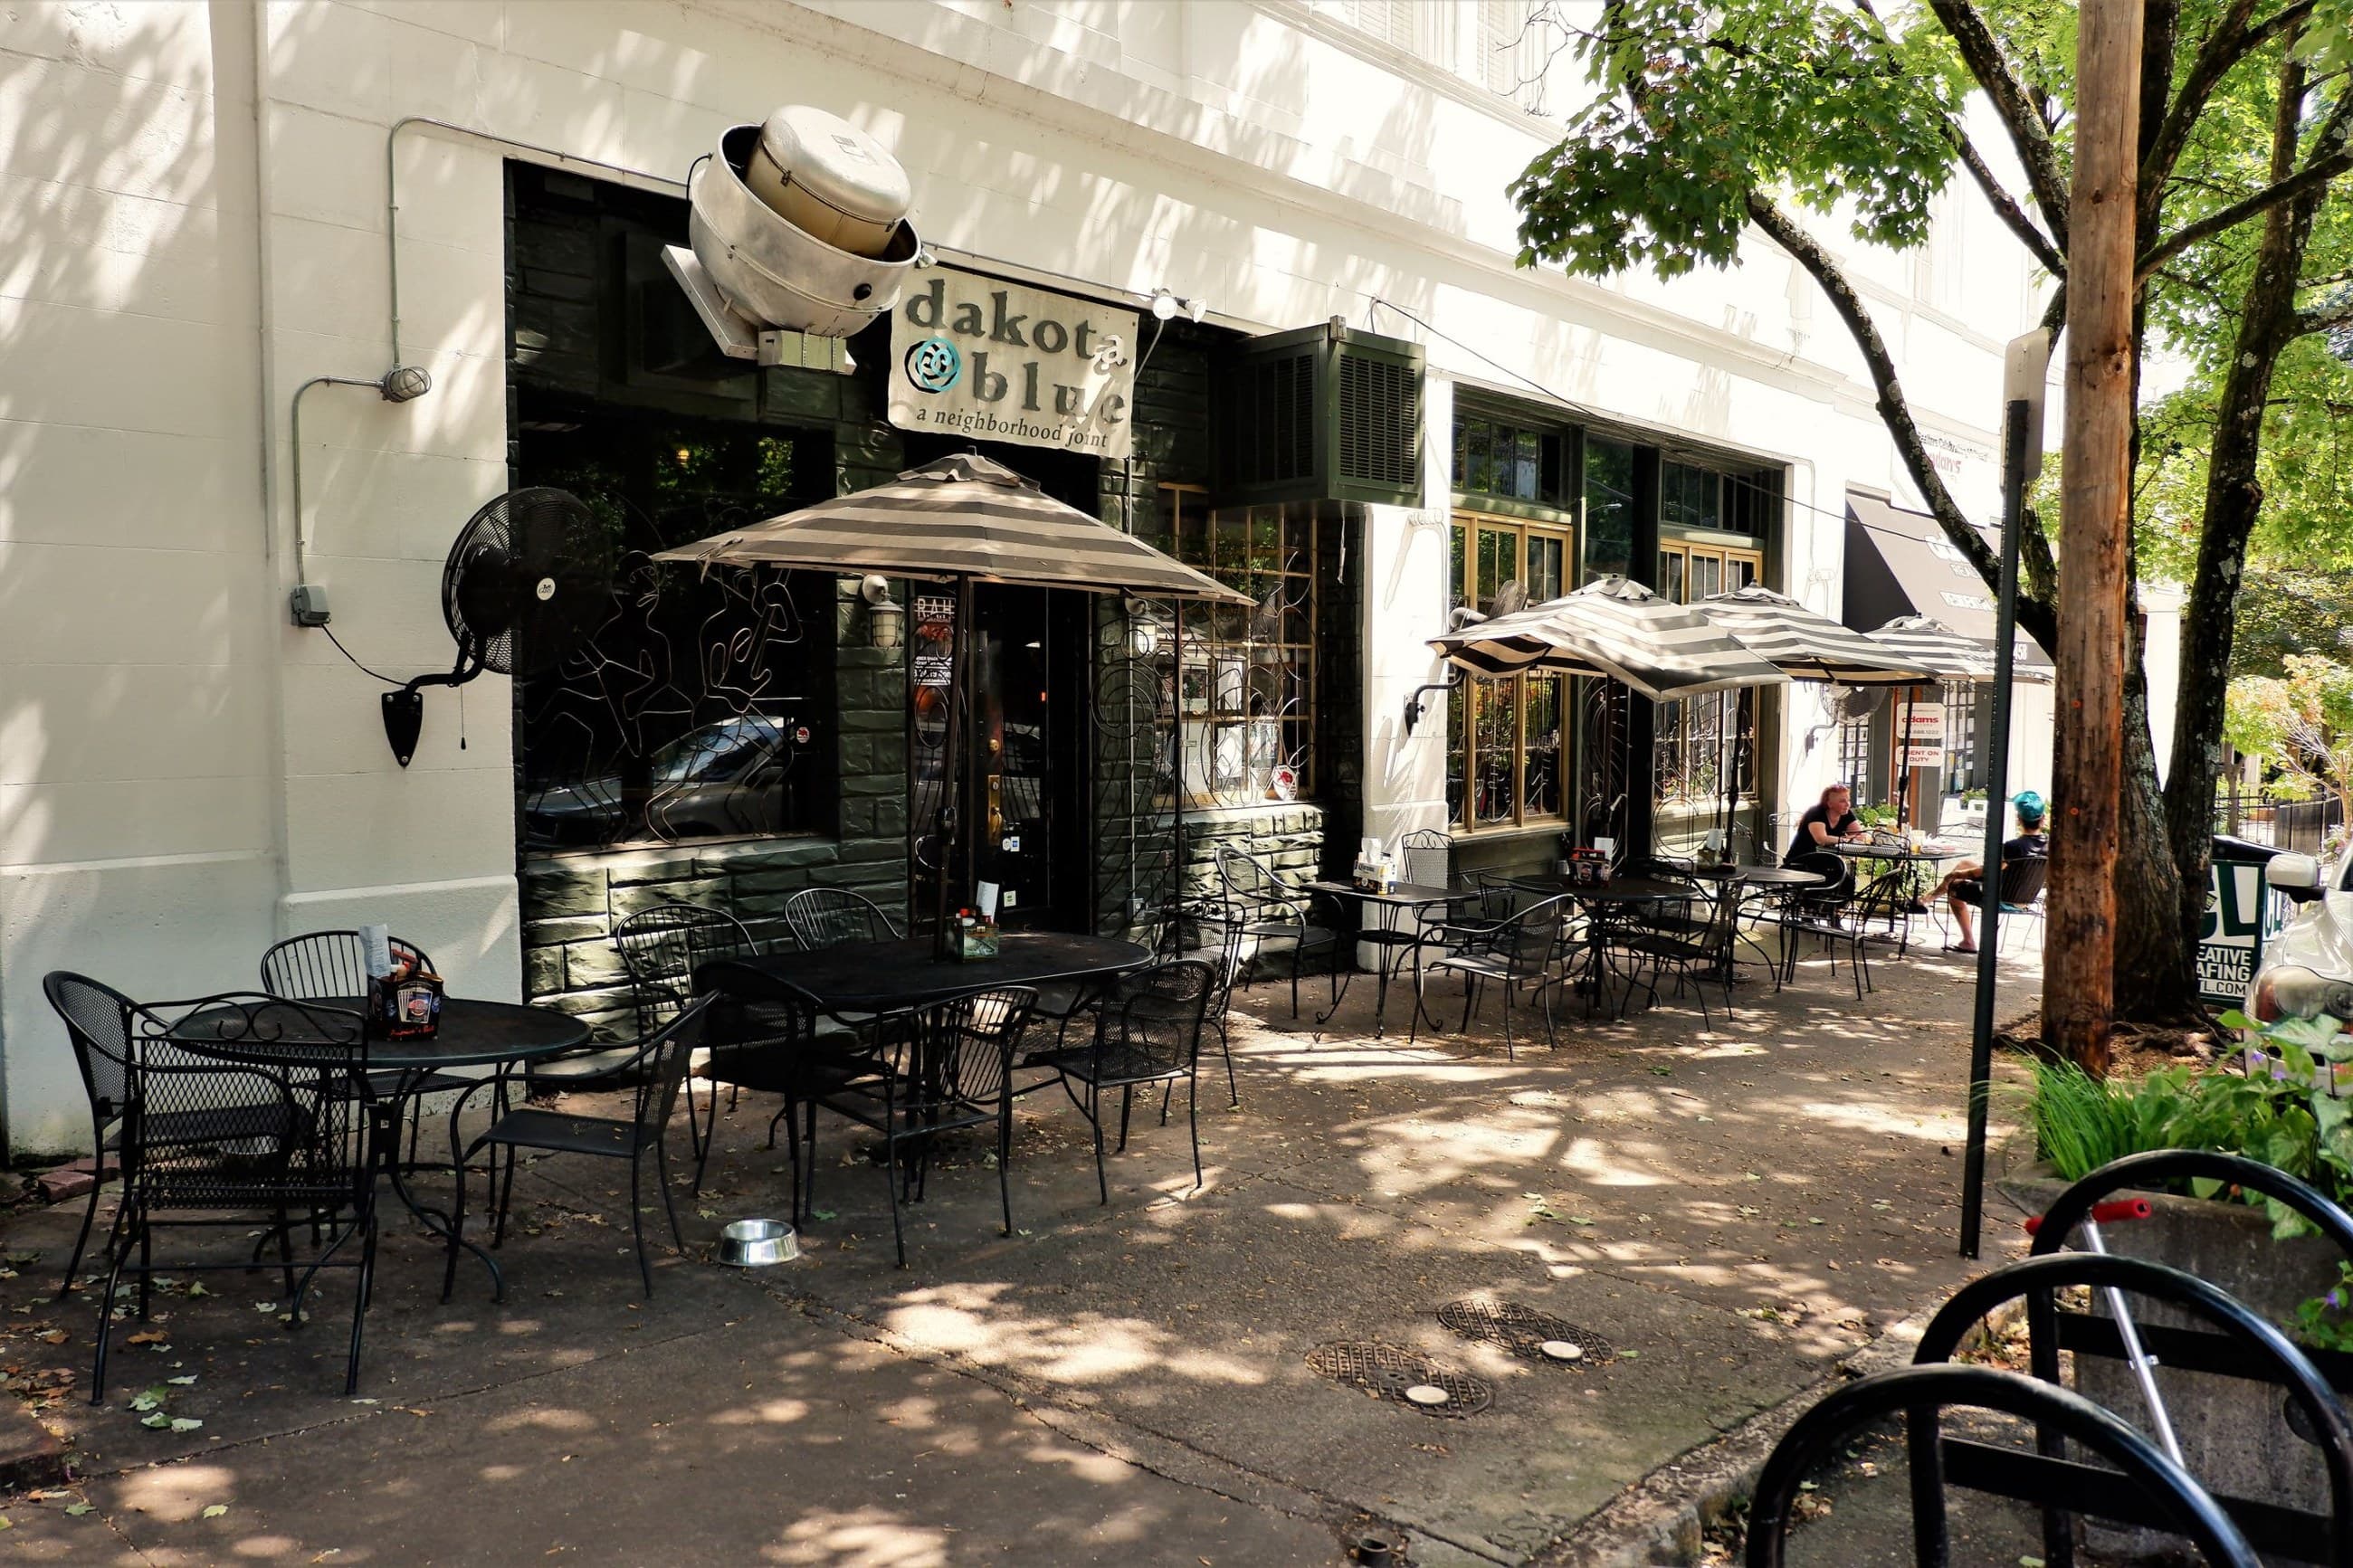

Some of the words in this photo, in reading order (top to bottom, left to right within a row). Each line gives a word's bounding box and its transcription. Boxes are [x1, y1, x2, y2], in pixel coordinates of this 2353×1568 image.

[906, 279, 1128, 375] dakota
[972, 352, 1125, 425] blue
[916, 407, 927, 422] a
[934, 408, 1062, 442] neighborhood
[1064, 424, 1109, 449] joint
[2202, 981, 2247, 994] L.COM
